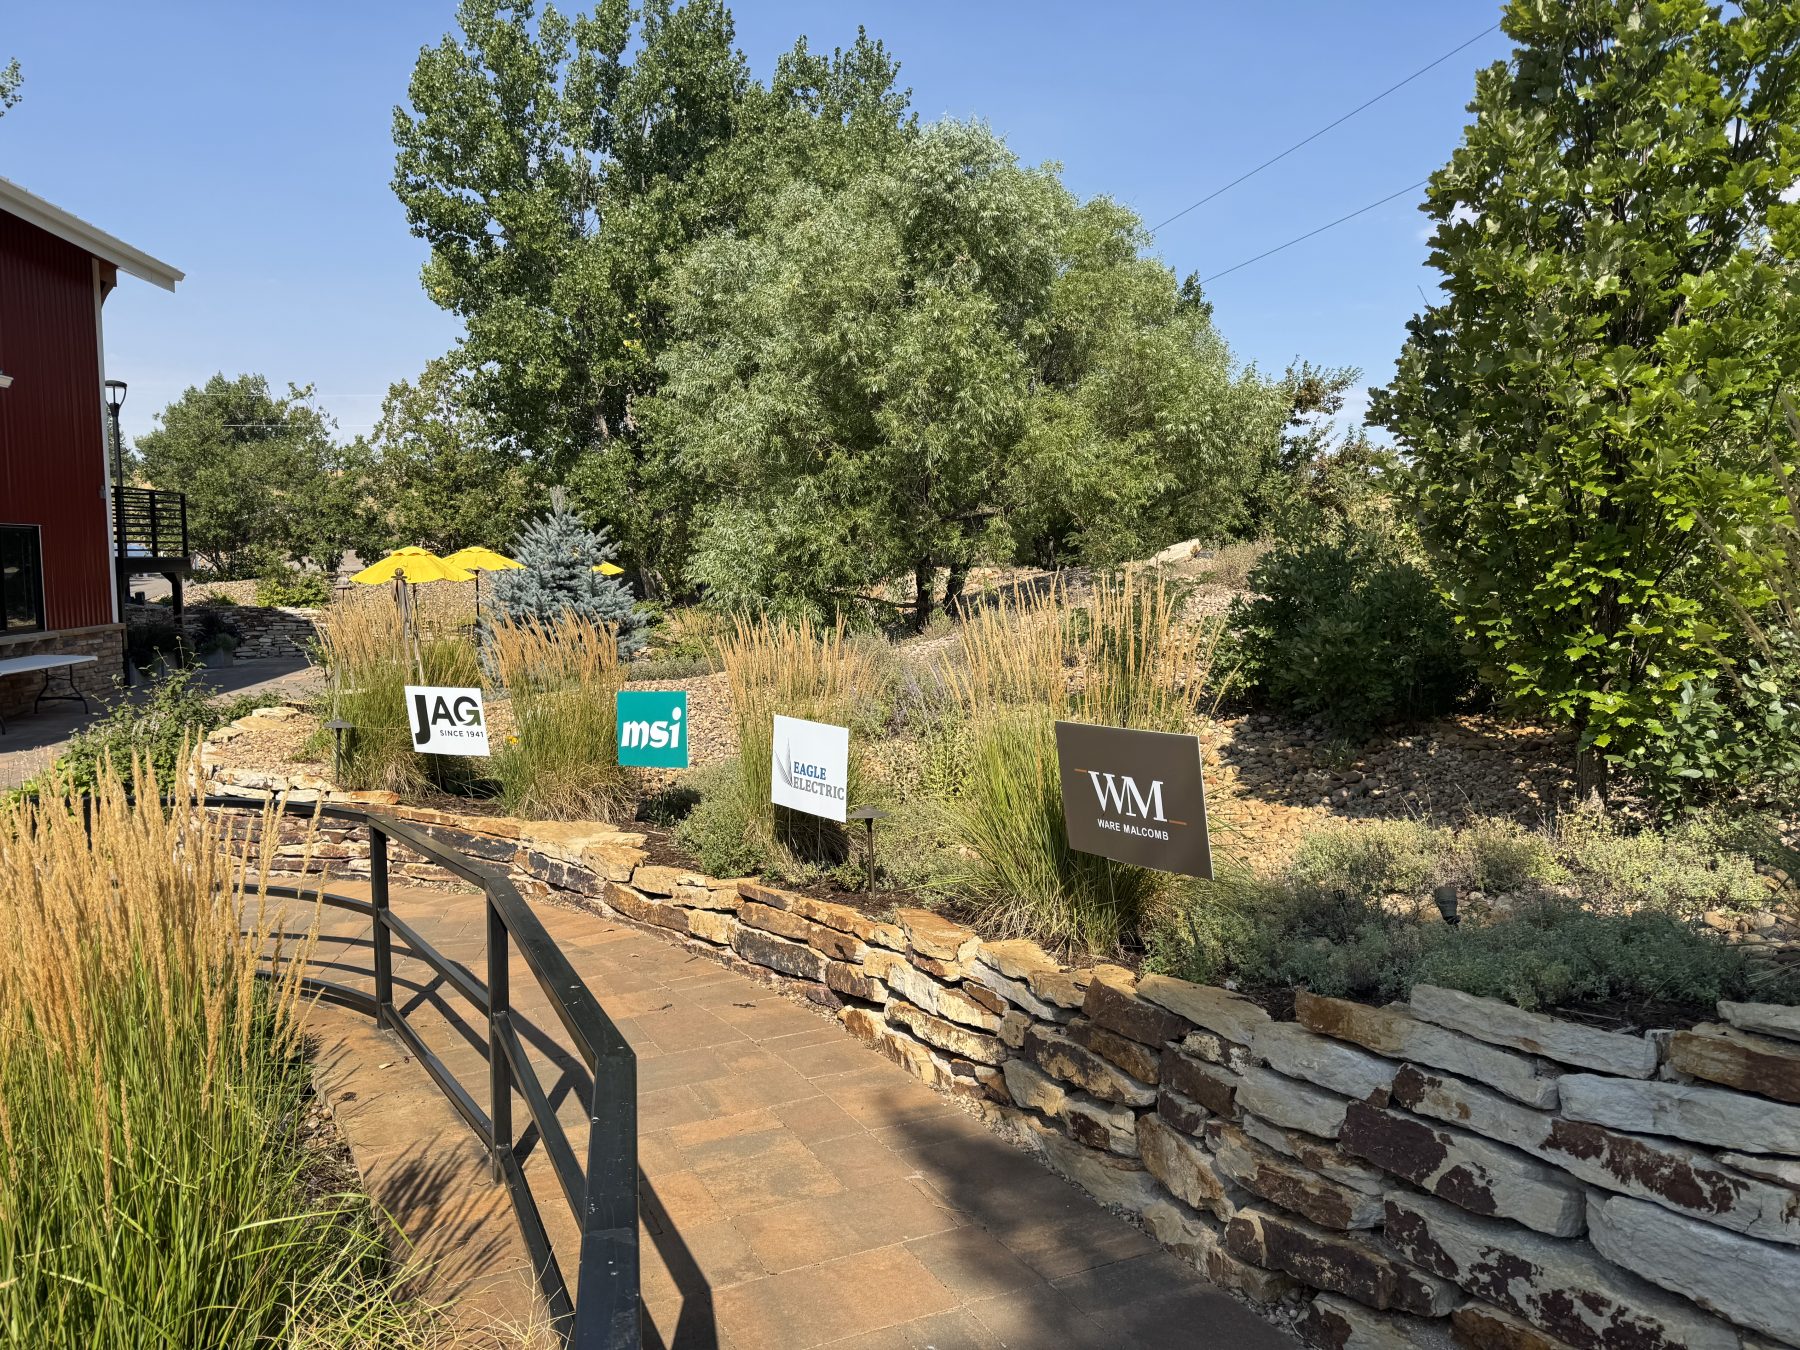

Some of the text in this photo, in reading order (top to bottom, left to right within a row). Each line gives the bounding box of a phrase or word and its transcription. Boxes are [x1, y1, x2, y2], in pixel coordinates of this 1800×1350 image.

[415, 695, 482, 745] JAG
[621, 706, 682, 750] msi
[793, 761, 827, 781] EAGLE
[793, 776, 845, 801] ELECTRIC
[1088, 770, 1168, 822] WM
[1097, 818, 1169, 841] WARE MALCOMB
